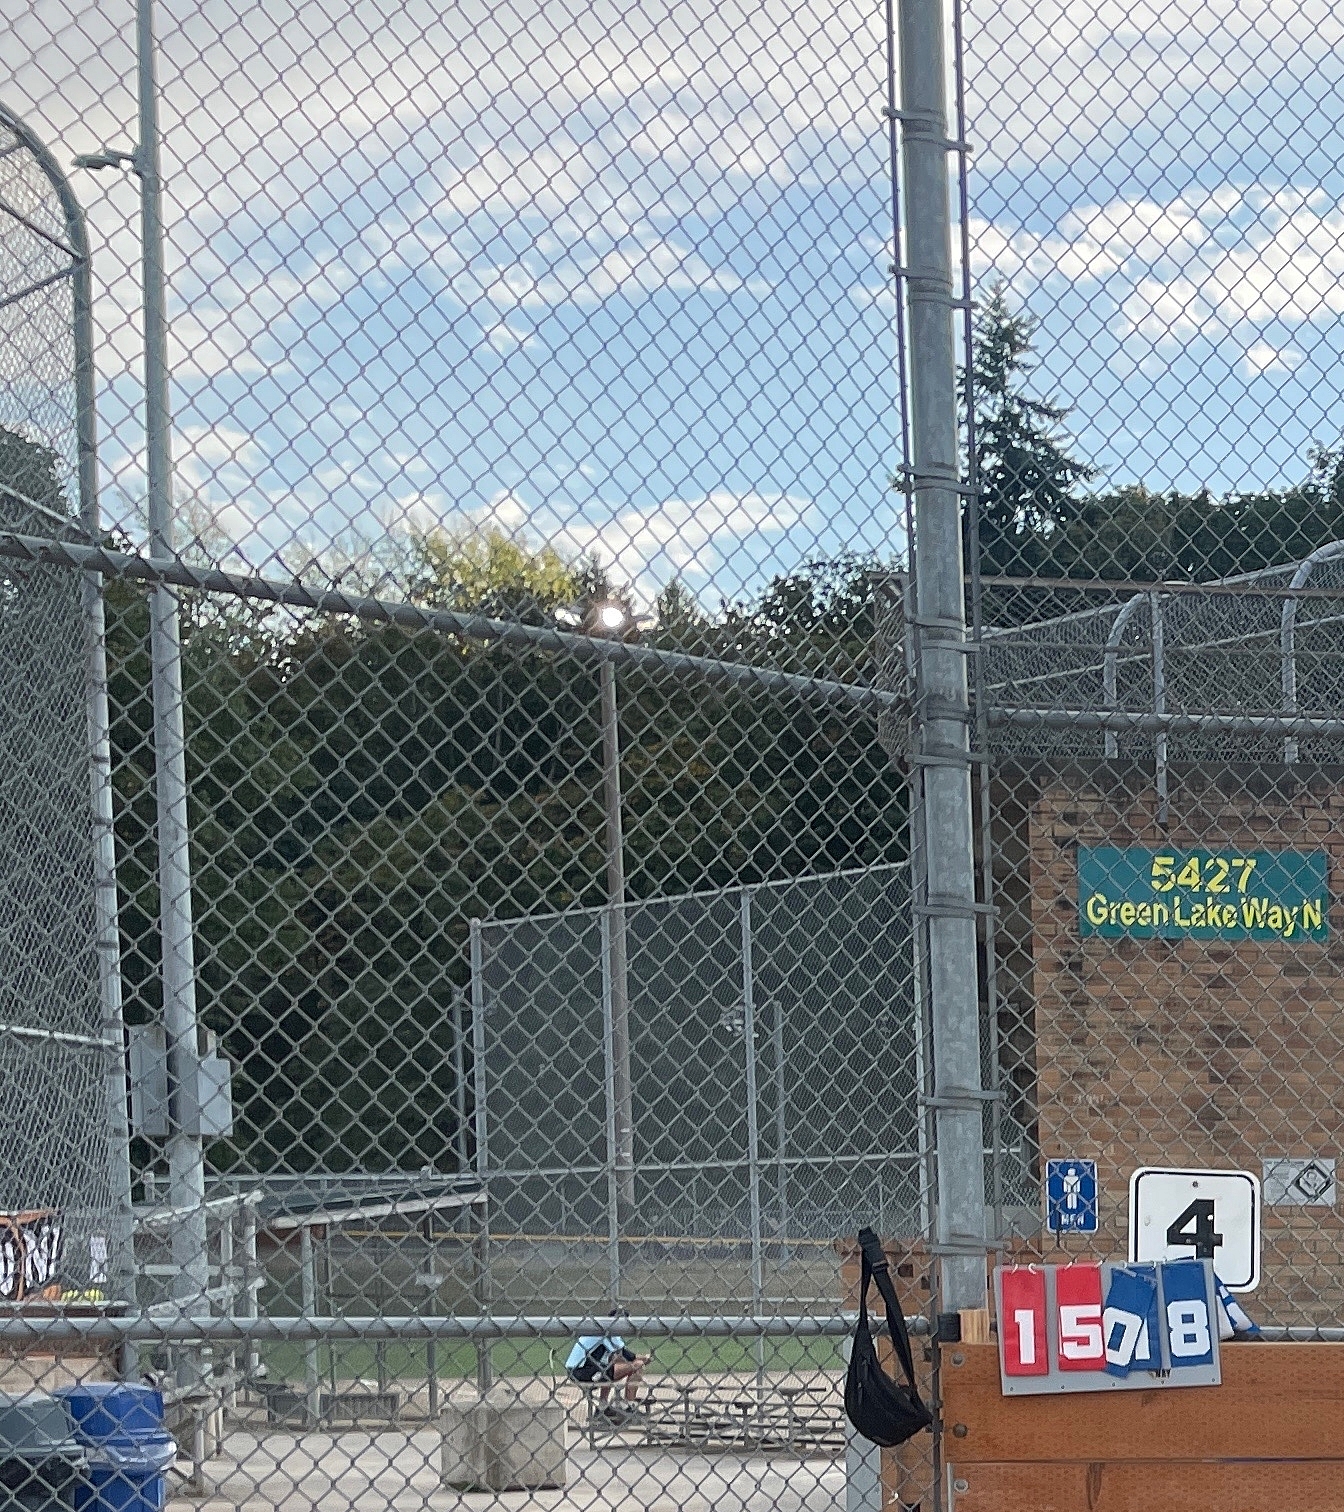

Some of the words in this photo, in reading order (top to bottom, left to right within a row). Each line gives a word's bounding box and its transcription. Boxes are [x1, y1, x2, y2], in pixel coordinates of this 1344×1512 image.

[1151, 856, 1257, 893] 5427
[1087, 894, 1169, 927] Green
[1175, 896, 1238, 928] Lake
[1242, 897, 1299, 937] Way
[1303, 898, 1322, 930] N
[1167, 1199, 1223, 1258] 4
